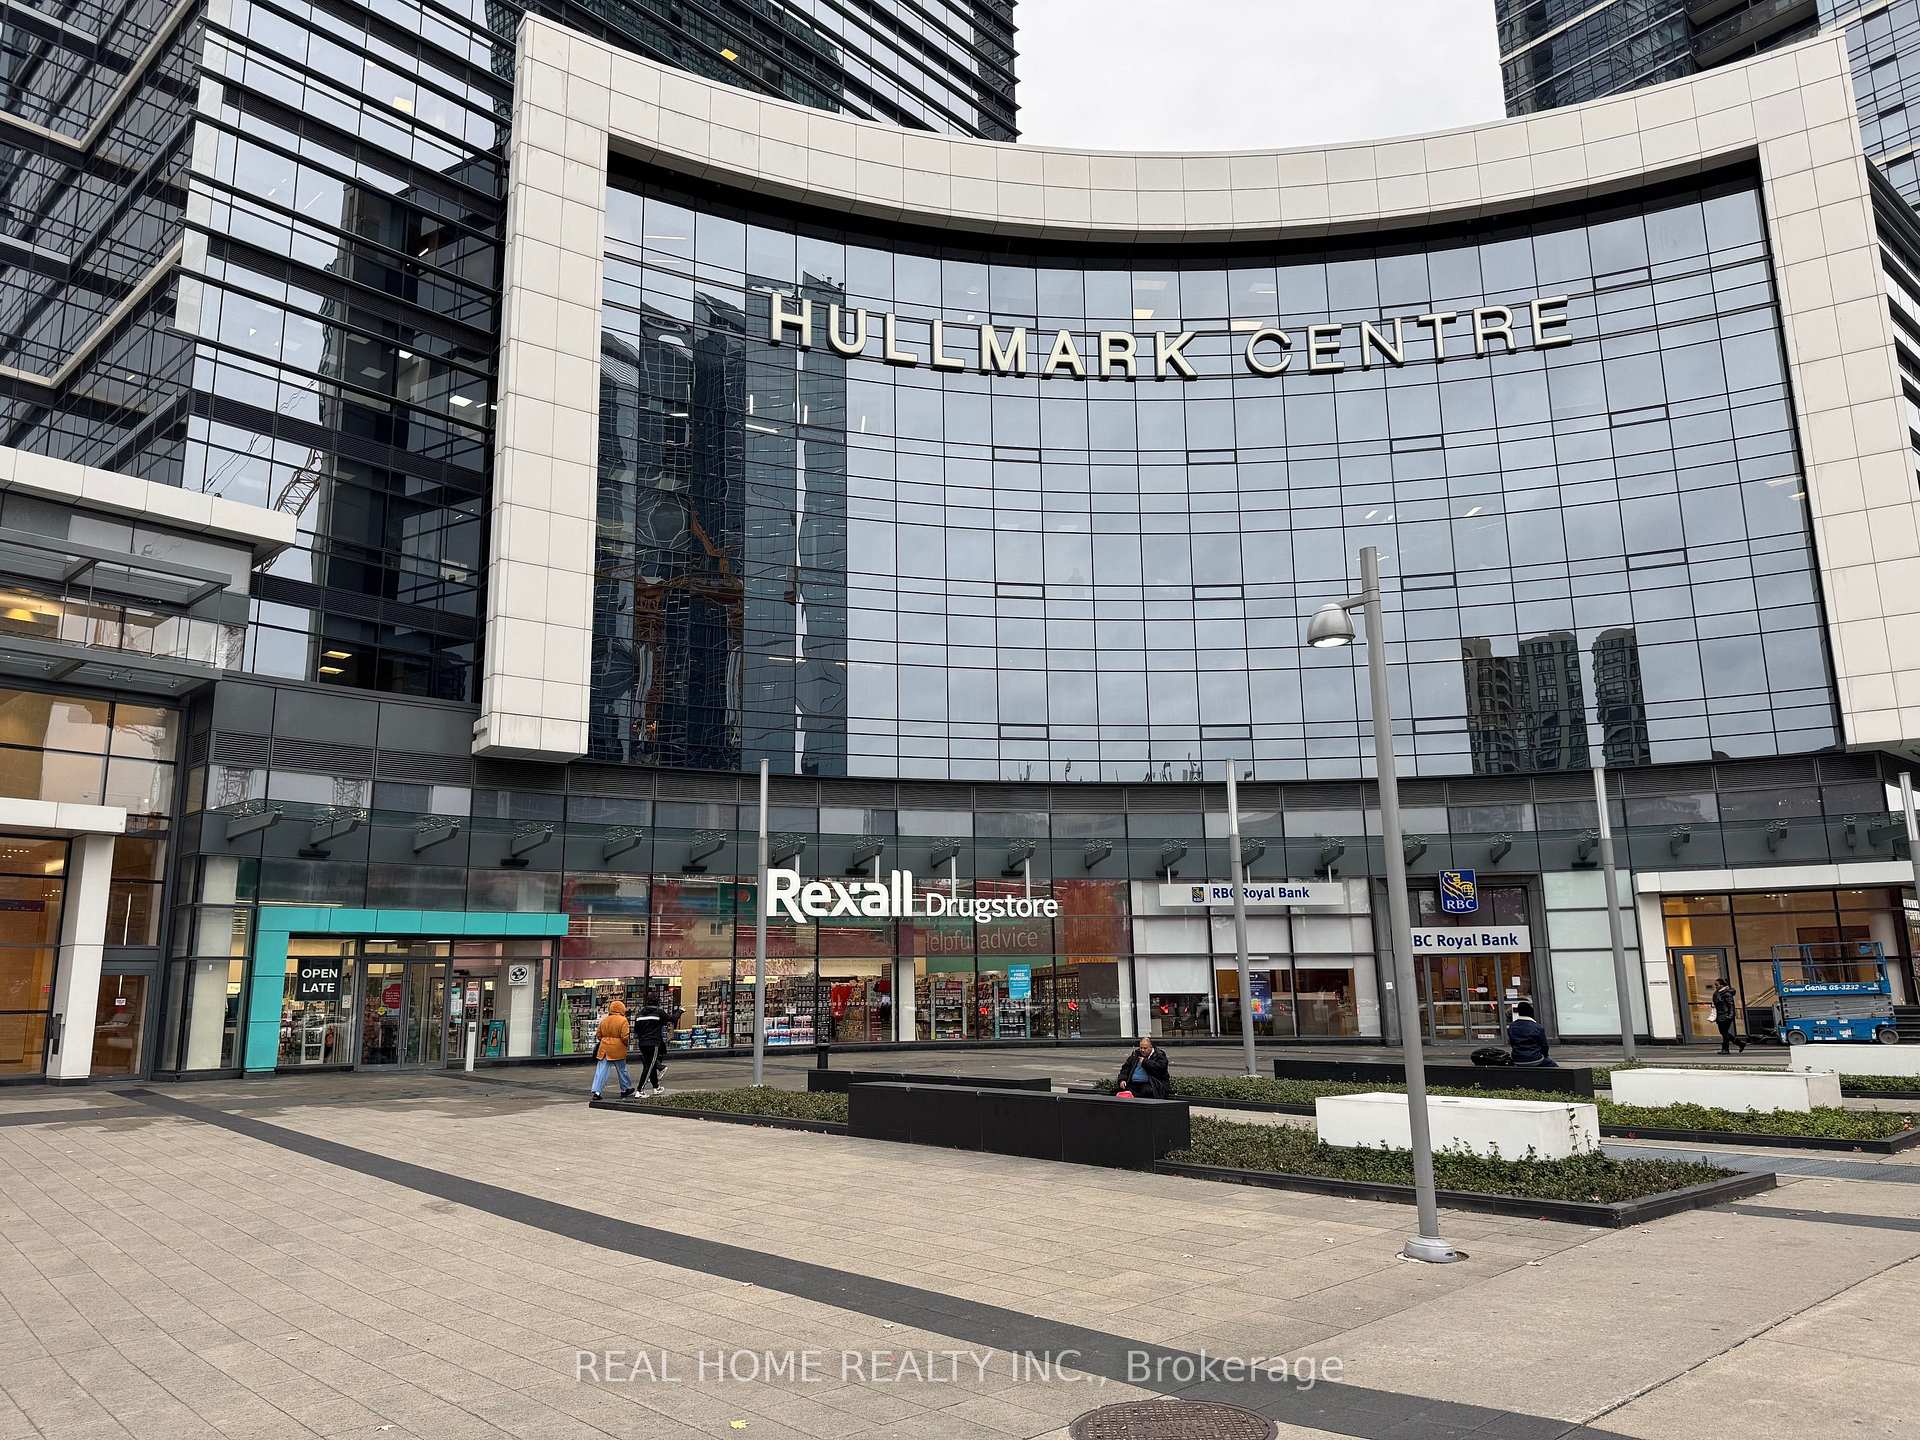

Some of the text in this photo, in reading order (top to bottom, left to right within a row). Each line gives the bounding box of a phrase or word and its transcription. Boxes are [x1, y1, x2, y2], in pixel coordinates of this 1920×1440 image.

[769, 292, 1573, 382] HULLMARK CENTRE
[766, 868, 1059, 924] Rexall Drugstore
[1243, 886, 1275, 901] Royal
[1278, 886, 1310, 898] Bank
[1446, 899, 1475, 909] RBC
[926, 926, 1039, 953] elpful advice
[1413, 932, 1519, 949] BC Royal Bank
[301, 968, 338, 979] OPEN
[302, 983, 335, 993] LATE
